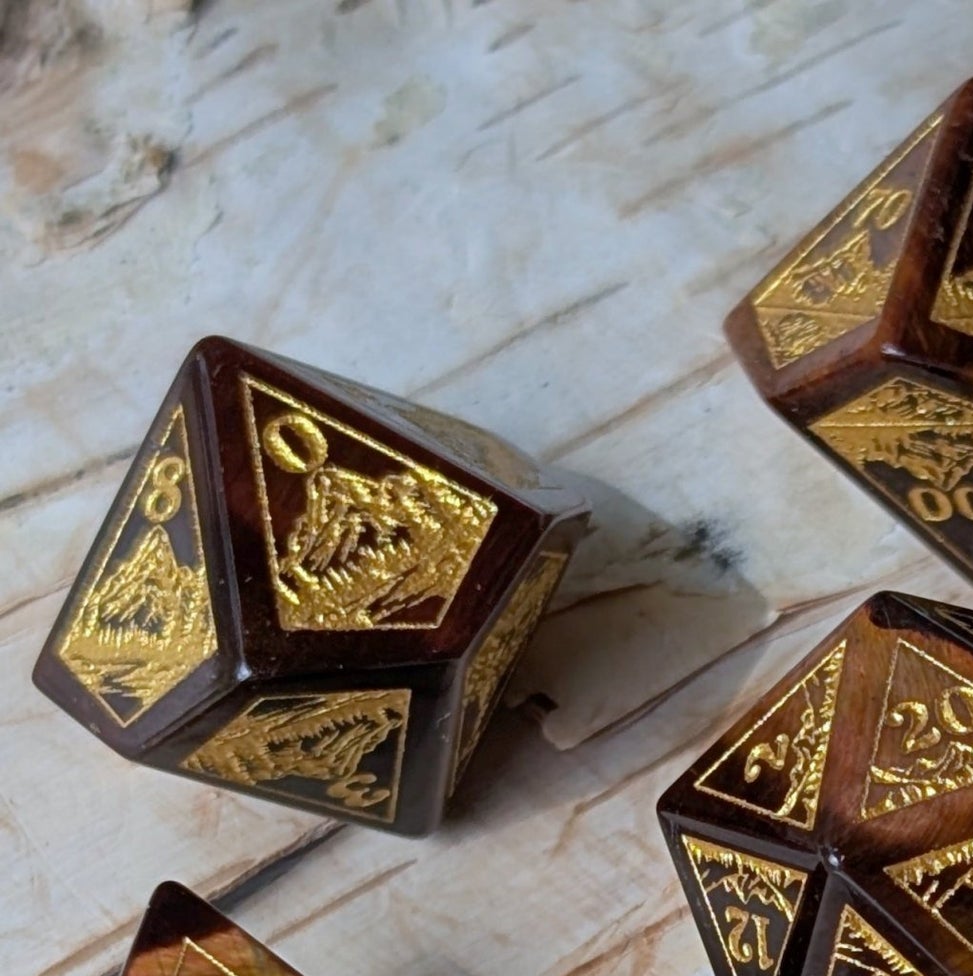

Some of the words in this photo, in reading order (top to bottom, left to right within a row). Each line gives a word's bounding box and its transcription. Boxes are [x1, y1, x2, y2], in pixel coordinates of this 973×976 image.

[853, 187, 913, 230] 70
[261, 414, 329, 474] 0
[144, 455, 185, 523] 8
[743, 733, 790, 784] 2
[724, 904, 775, 971] 12
